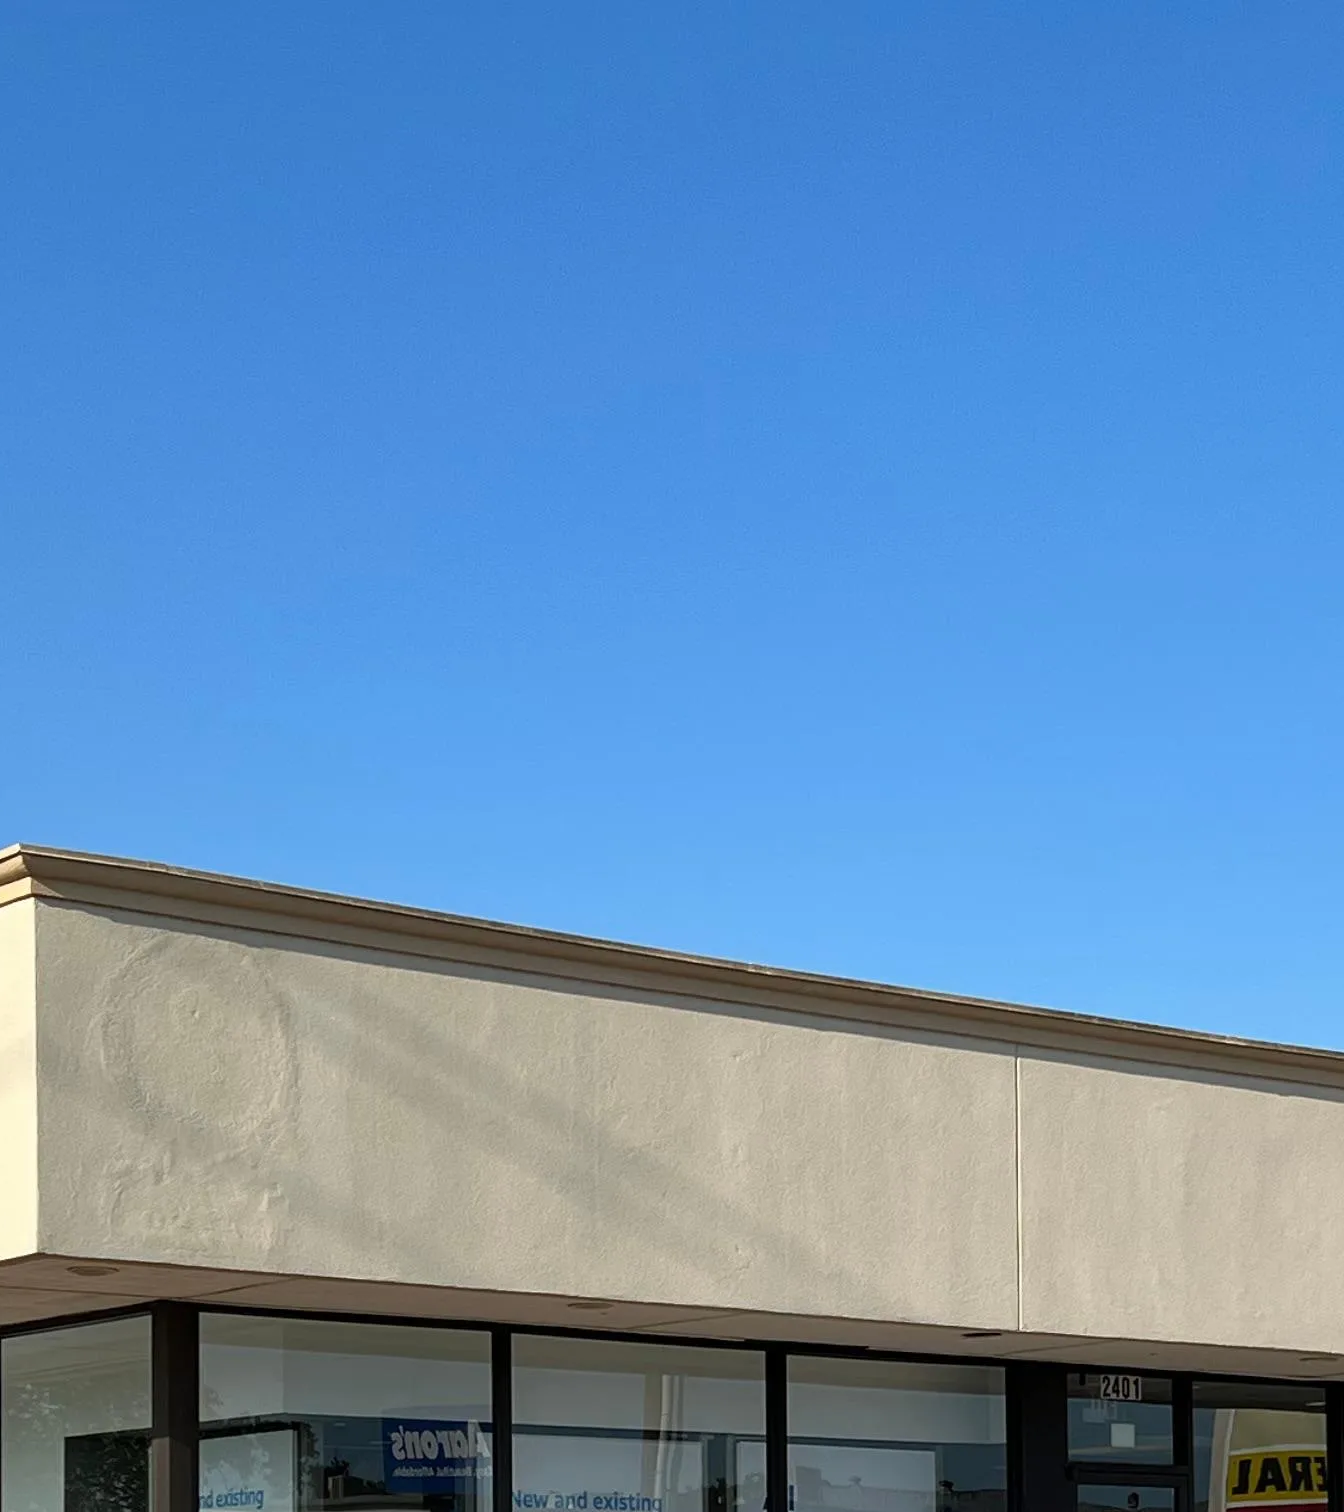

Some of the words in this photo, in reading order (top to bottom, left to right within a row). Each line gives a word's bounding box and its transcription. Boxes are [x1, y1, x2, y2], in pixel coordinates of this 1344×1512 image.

[1102, 1376, 1141, 1399] 2401
[216, 1487, 264, 1509] existing
[512, 1491, 547, 1508] New
[553, 1491, 587, 1509] and
